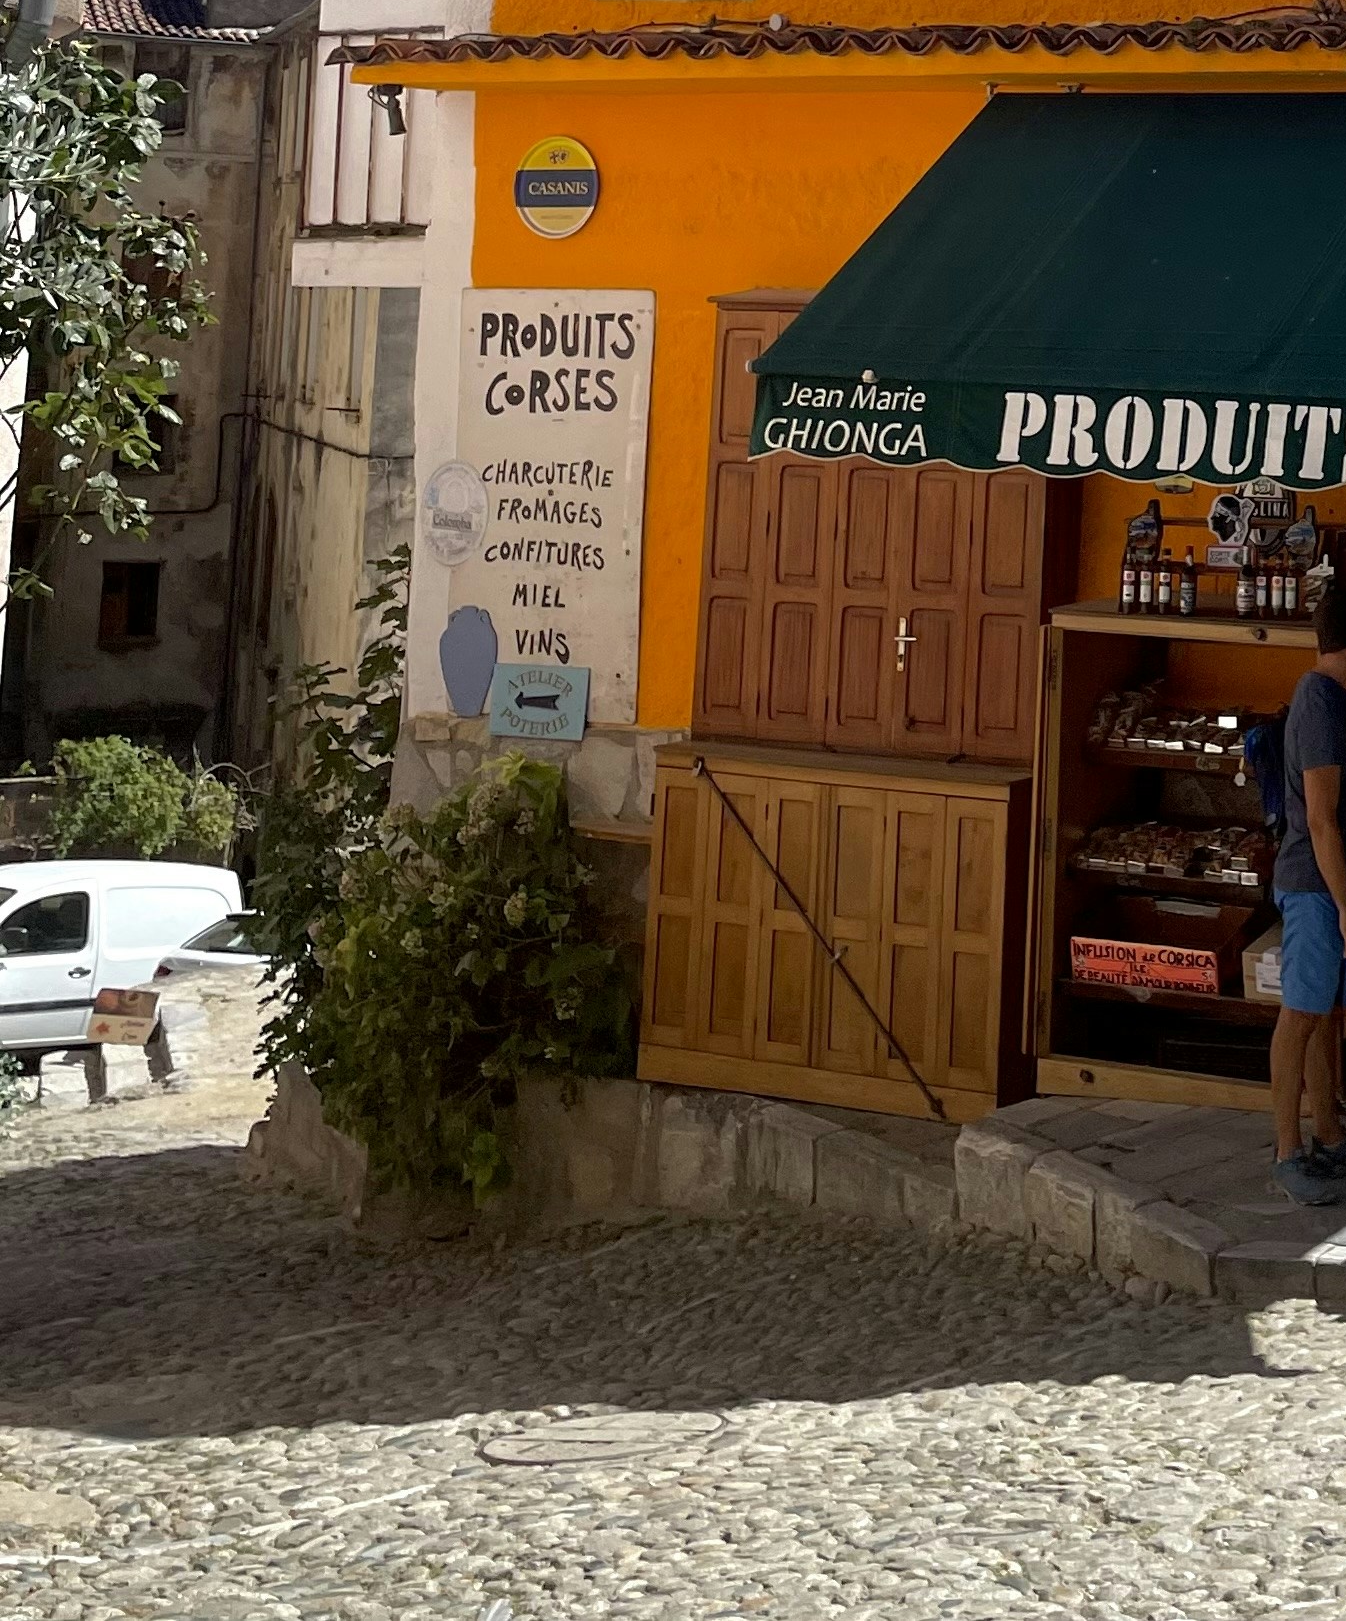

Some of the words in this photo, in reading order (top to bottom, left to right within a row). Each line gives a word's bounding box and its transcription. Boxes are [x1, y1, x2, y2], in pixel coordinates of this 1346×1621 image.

[528, 181, 589, 196] CASANIS
[480, 312, 636, 362] PRODUITS
[485, 369, 619, 416] CORSES
[782, 381, 845, 411] Jean
[850, 383, 926, 413] Marie
[763, 416, 927, 458] GHIONGA
[482, 460, 613, 489] CHARCUTERIE
[497, 496, 602, 528] FROMAGES
[1254, 501, 1289, 518] LINA
[484, 539, 605, 571] CONFITURES
[512, 584, 566, 609] MIEL
[515, 628, 571, 664] VINS
[507, 670, 573, 697] ATELIER
[500, 707, 570, 736] POTERIE
[1157, 949, 1216, 968] CORSICA
